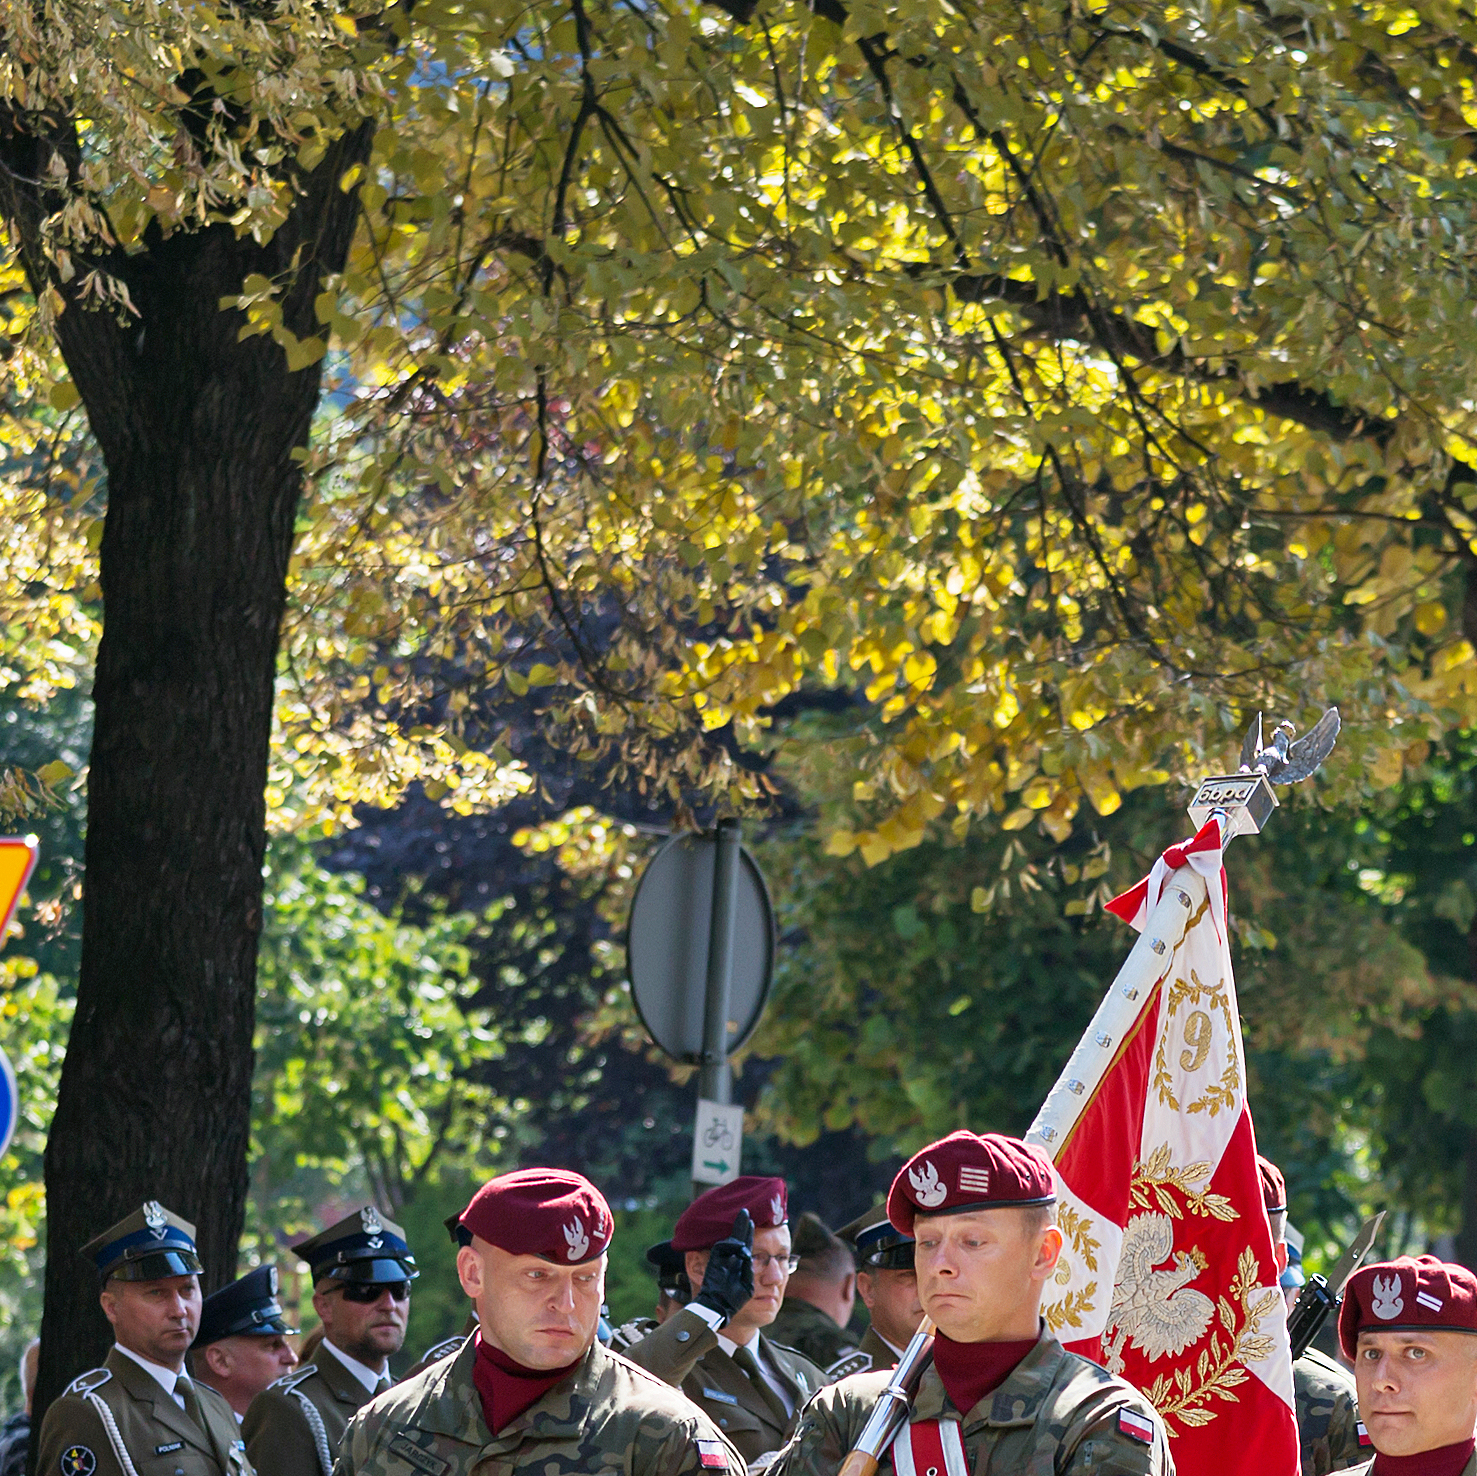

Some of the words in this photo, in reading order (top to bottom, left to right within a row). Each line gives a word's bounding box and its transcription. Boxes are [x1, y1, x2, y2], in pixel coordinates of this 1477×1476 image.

[1198, 784, 1254, 805] 6bpd
[1179, 1010, 1213, 1073] 9
[400, 1443, 438, 1470] JARCZYK
